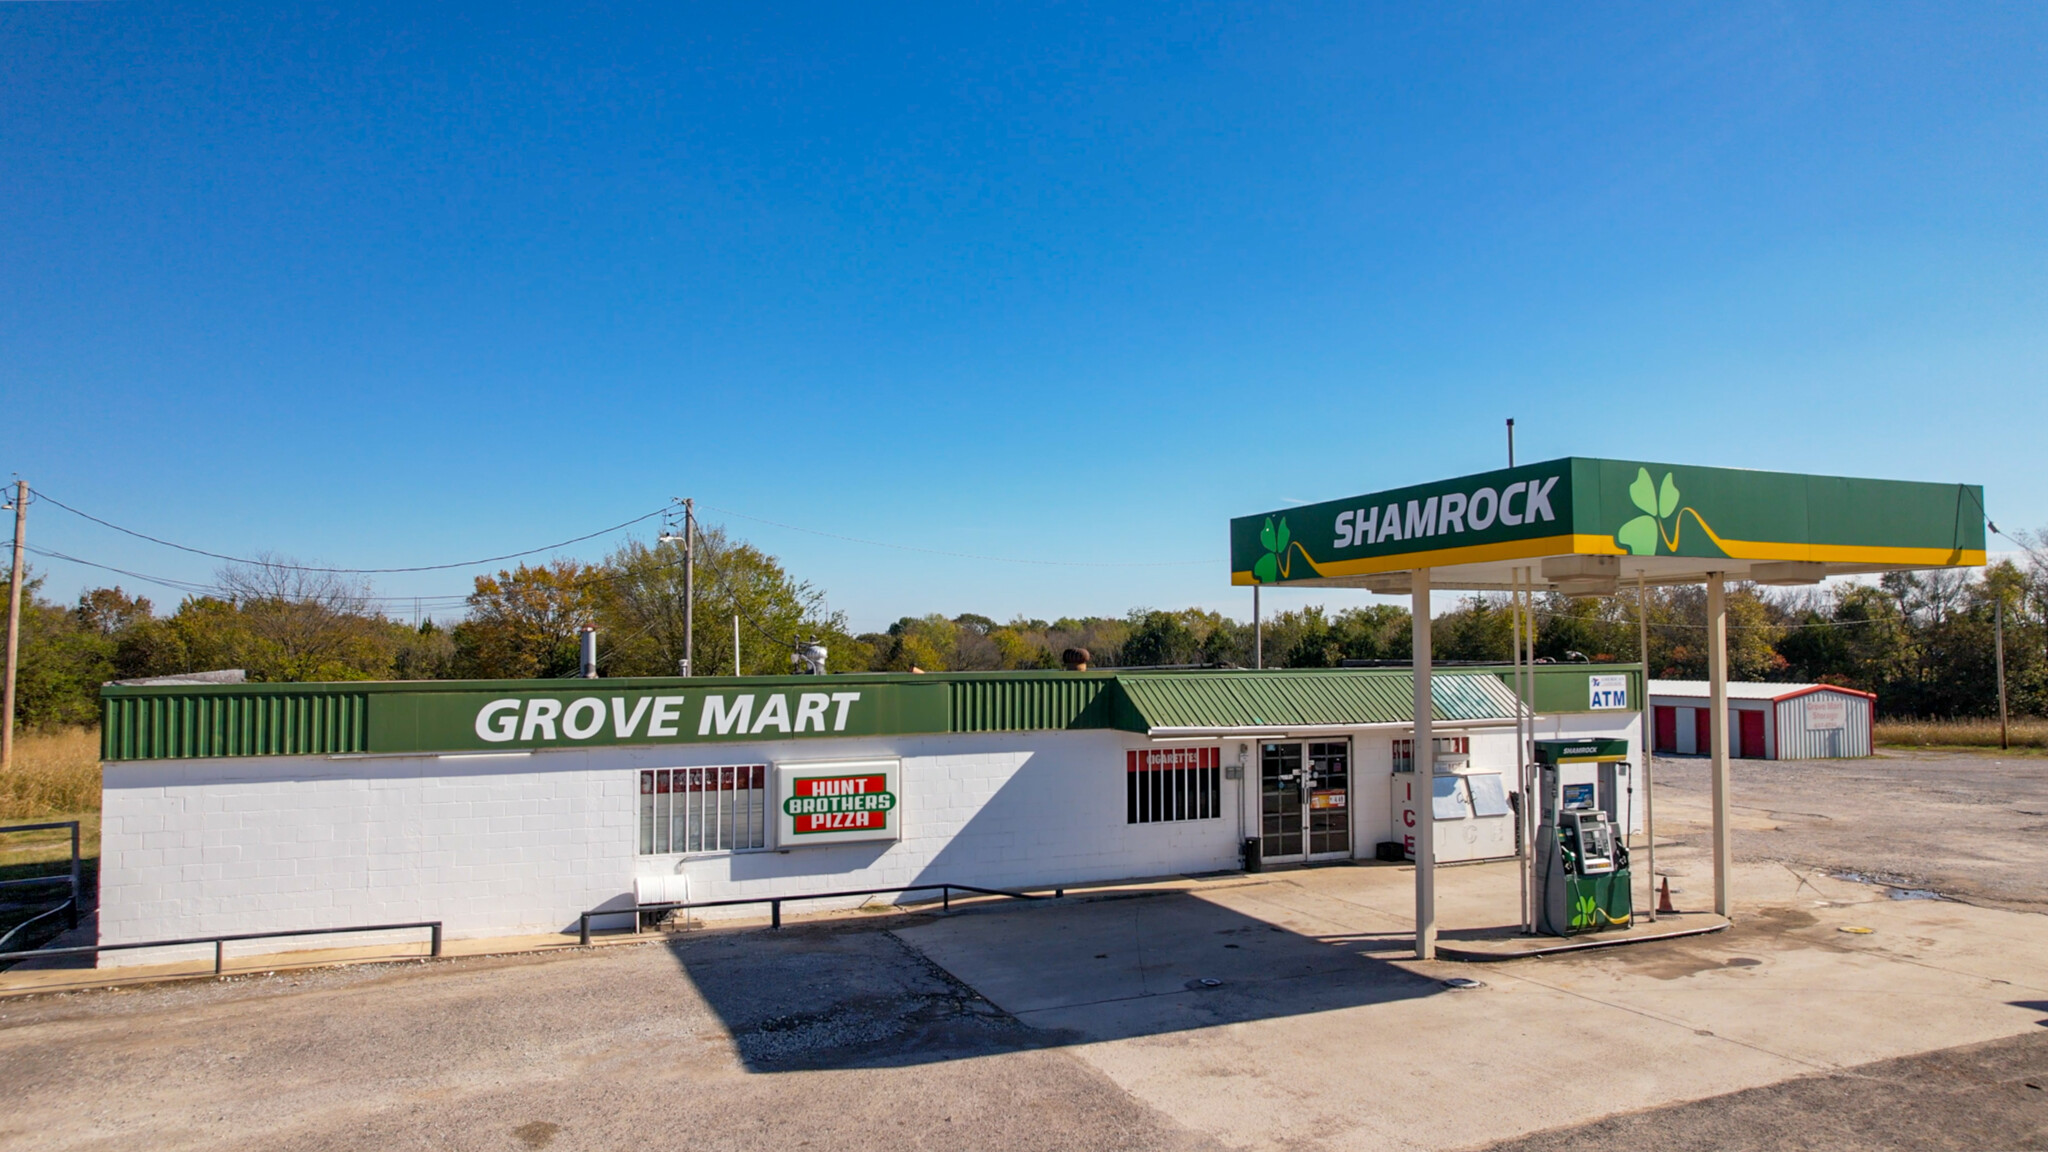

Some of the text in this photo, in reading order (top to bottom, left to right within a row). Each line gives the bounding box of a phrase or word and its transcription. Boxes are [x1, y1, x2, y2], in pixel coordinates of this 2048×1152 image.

[1333, 476, 1560, 548] SHAMROCK
[1591, 690, 1625, 707] ATM
[474, 692, 861, 742] GROVE MART
[812, 779, 868, 797] HUNT
[789, 794, 891, 814] BROTHERS
[811, 811, 869, 829] PIZZA
